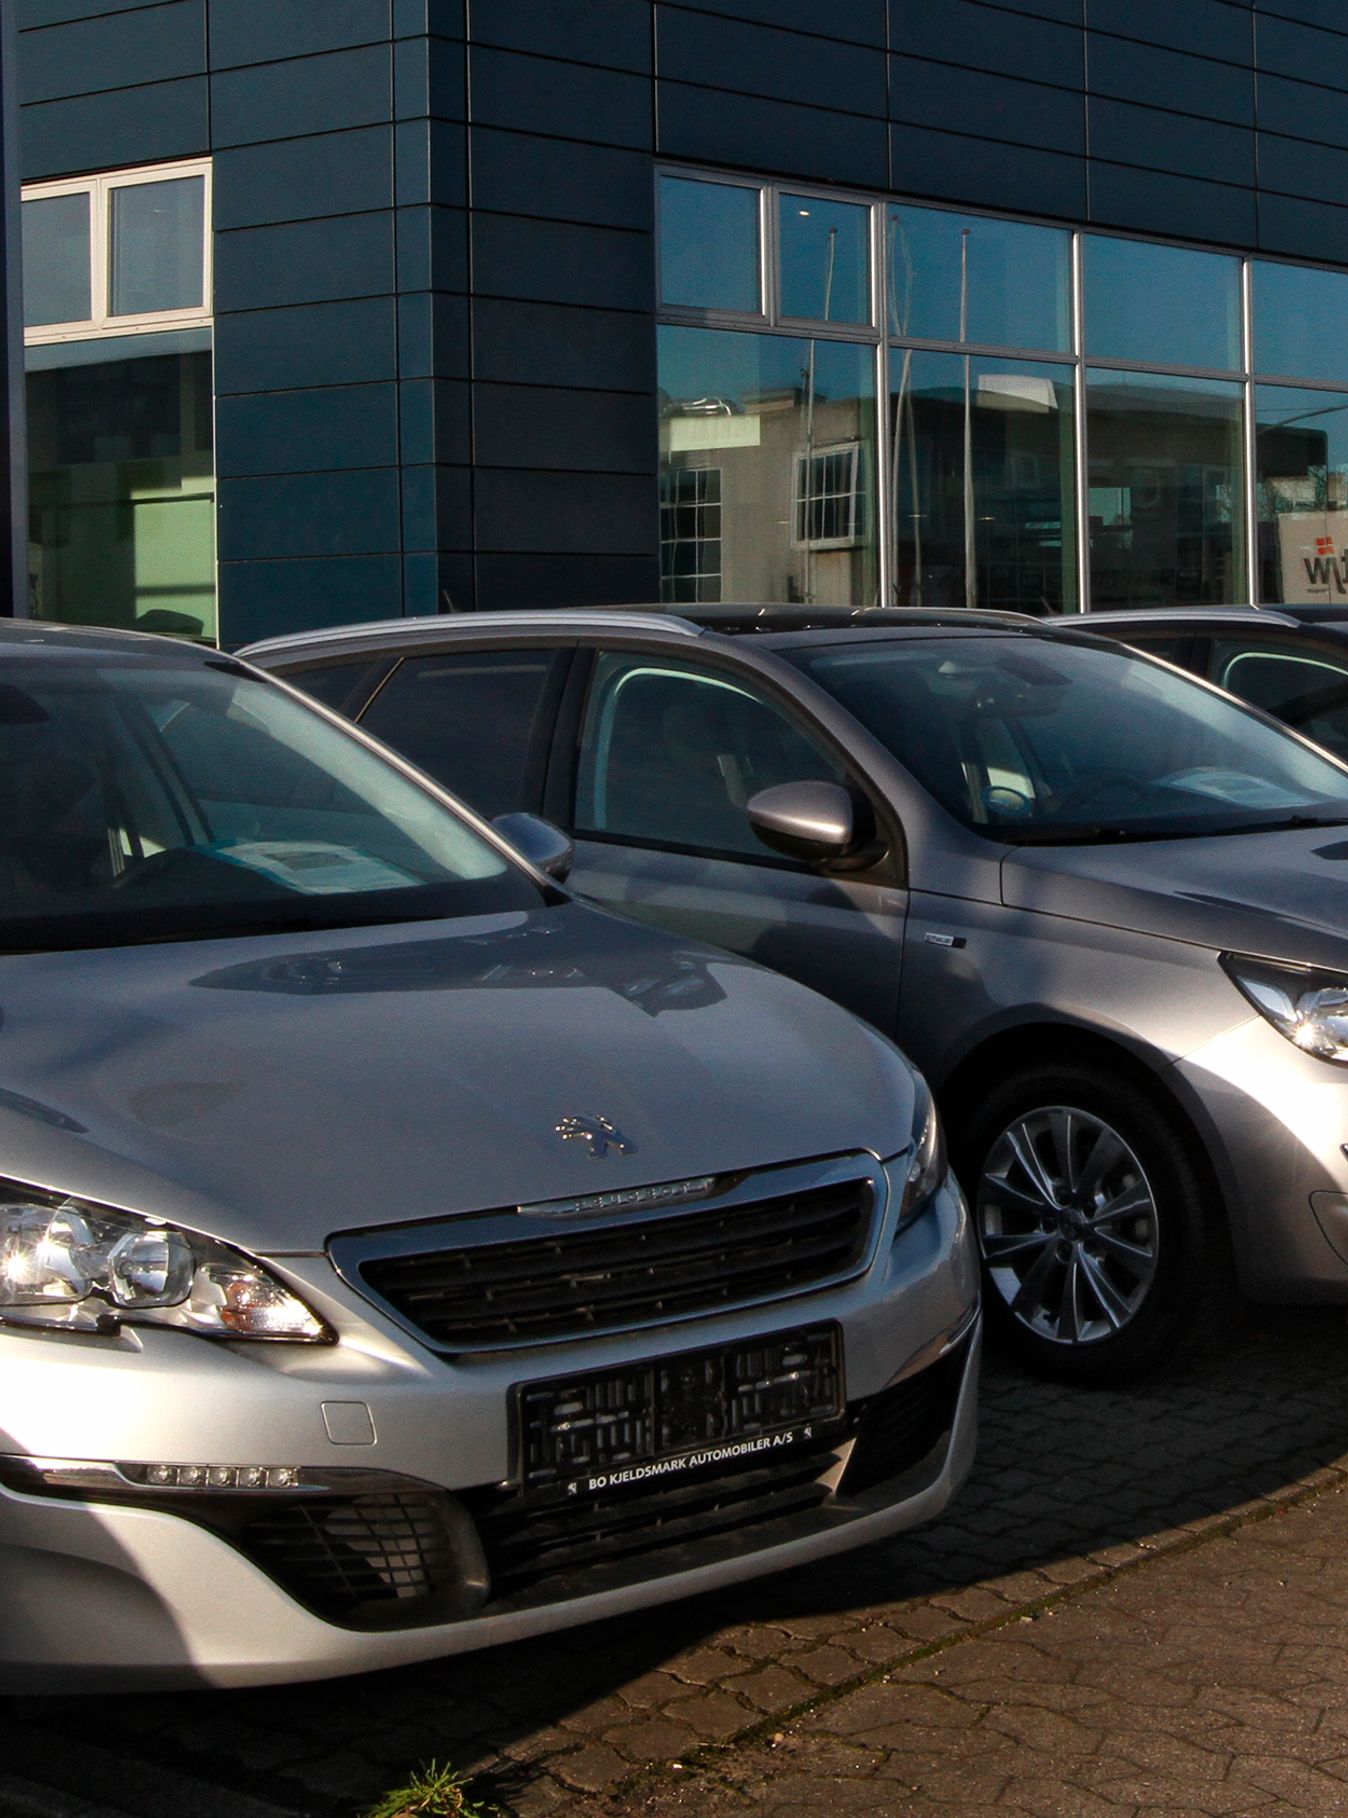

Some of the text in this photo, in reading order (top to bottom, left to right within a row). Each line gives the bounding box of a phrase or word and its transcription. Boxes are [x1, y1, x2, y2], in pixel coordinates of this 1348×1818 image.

[588, 1431, 793, 1490] BO KJELDSMARK AUTOMOBILER A/S
